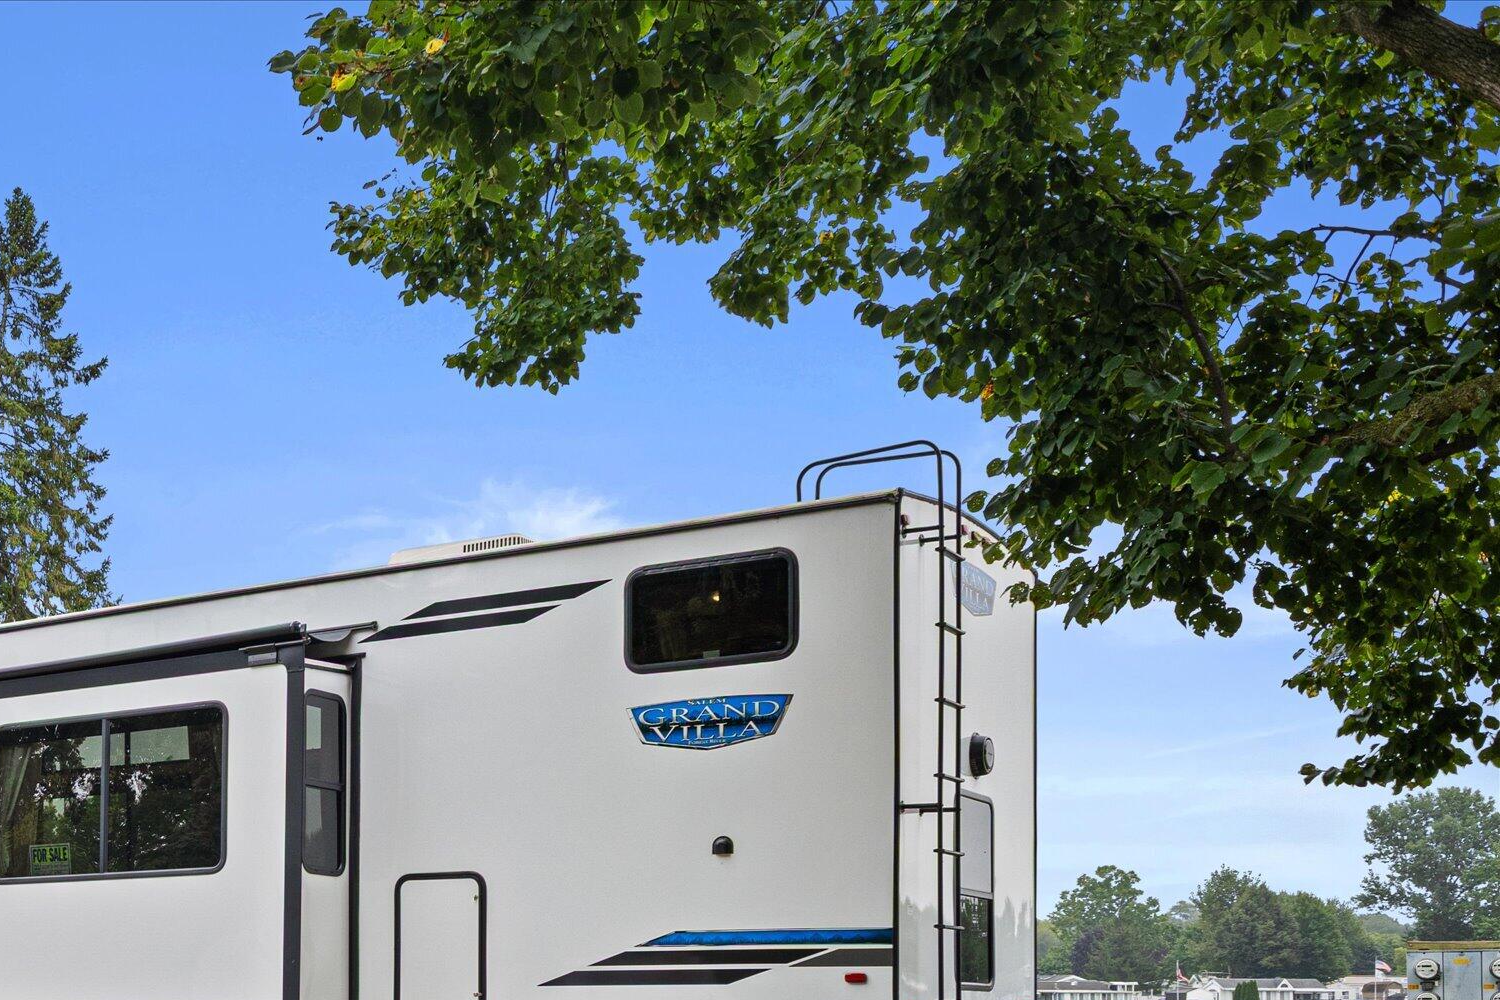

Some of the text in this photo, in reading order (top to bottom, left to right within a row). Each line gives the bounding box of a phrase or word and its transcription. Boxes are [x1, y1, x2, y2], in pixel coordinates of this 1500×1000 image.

[638, 700, 781, 726] GRAND
[649, 720, 763, 743] VILLA
[32, 847, 68, 863] FOR SALE
